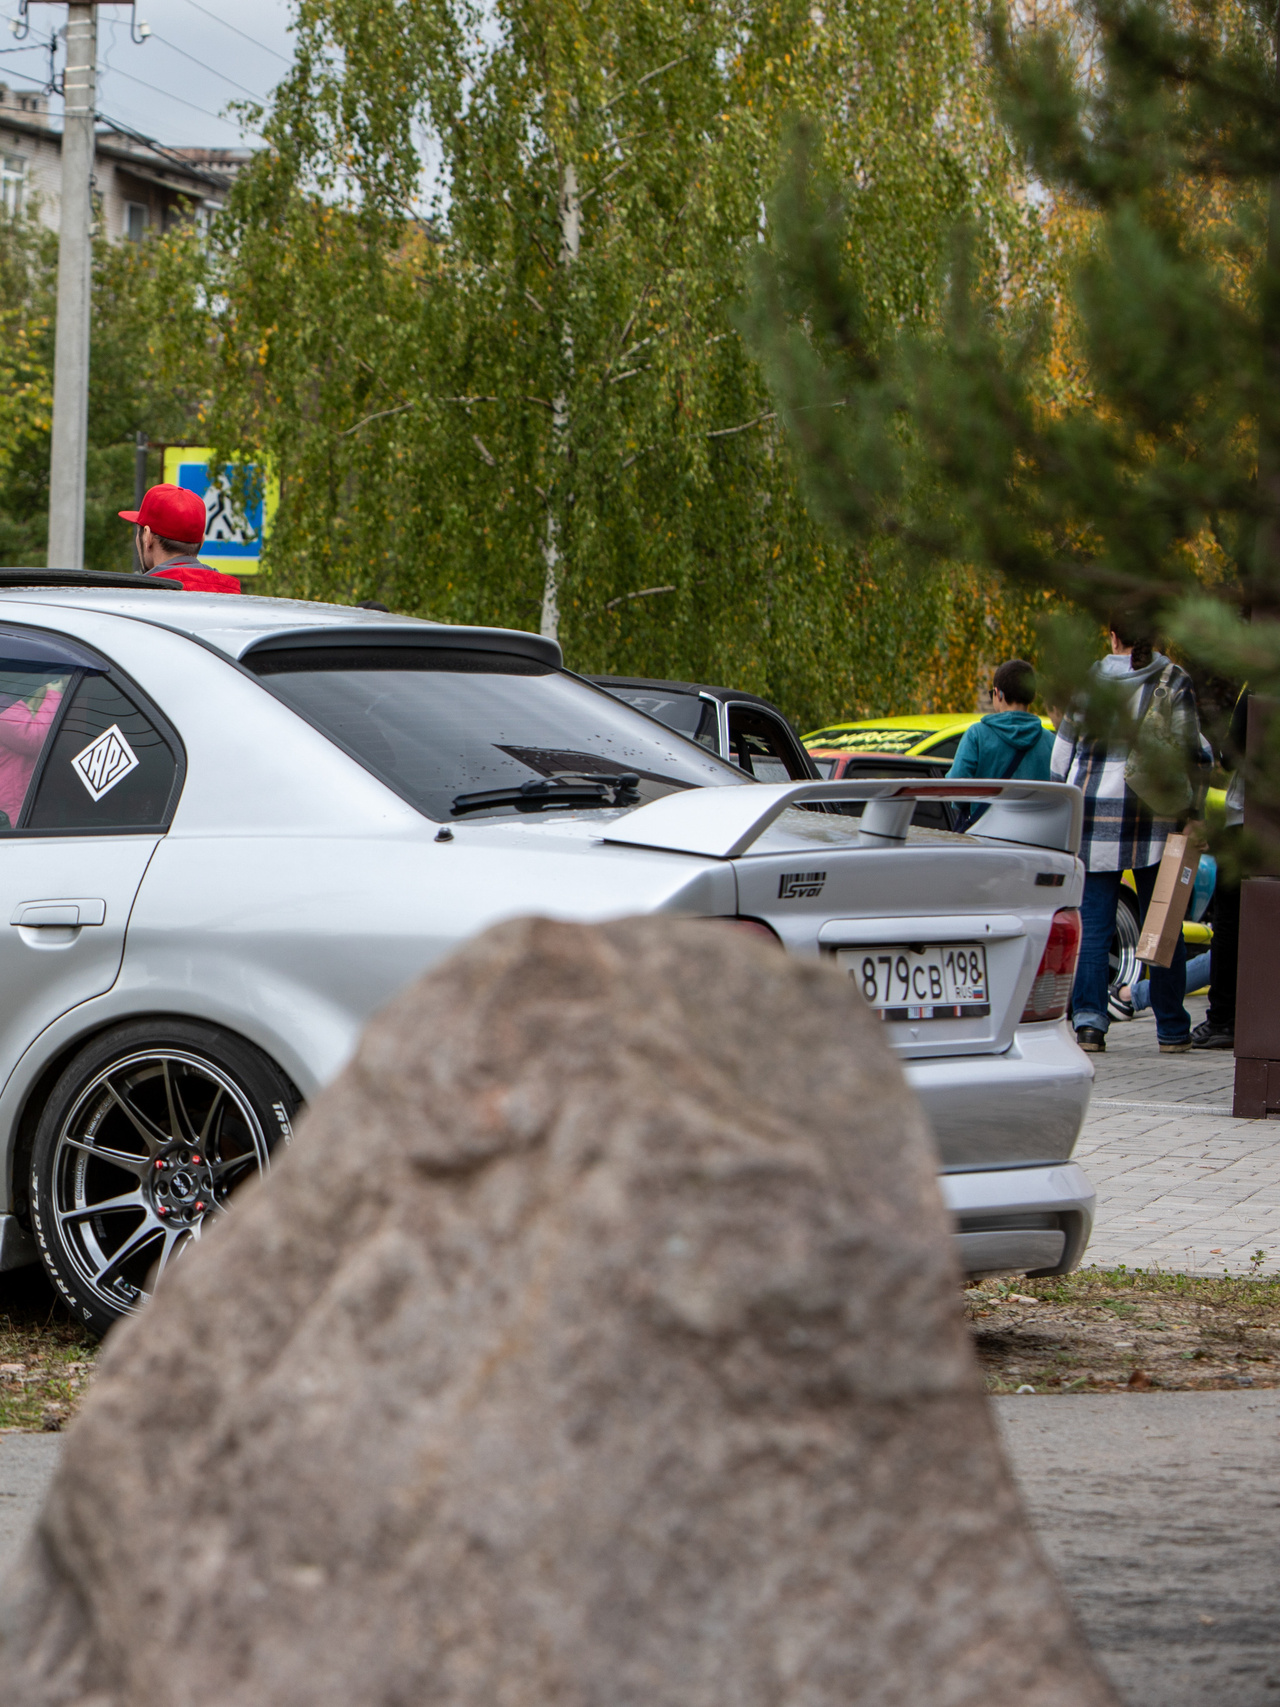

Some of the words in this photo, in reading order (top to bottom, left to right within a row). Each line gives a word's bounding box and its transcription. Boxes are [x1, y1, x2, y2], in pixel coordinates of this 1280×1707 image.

[848, 956, 943, 1003] 879CB
[946, 951, 982, 985] 198
[955, 987, 972, 999] RUS
[272, 1101, 295, 1146] TR96
